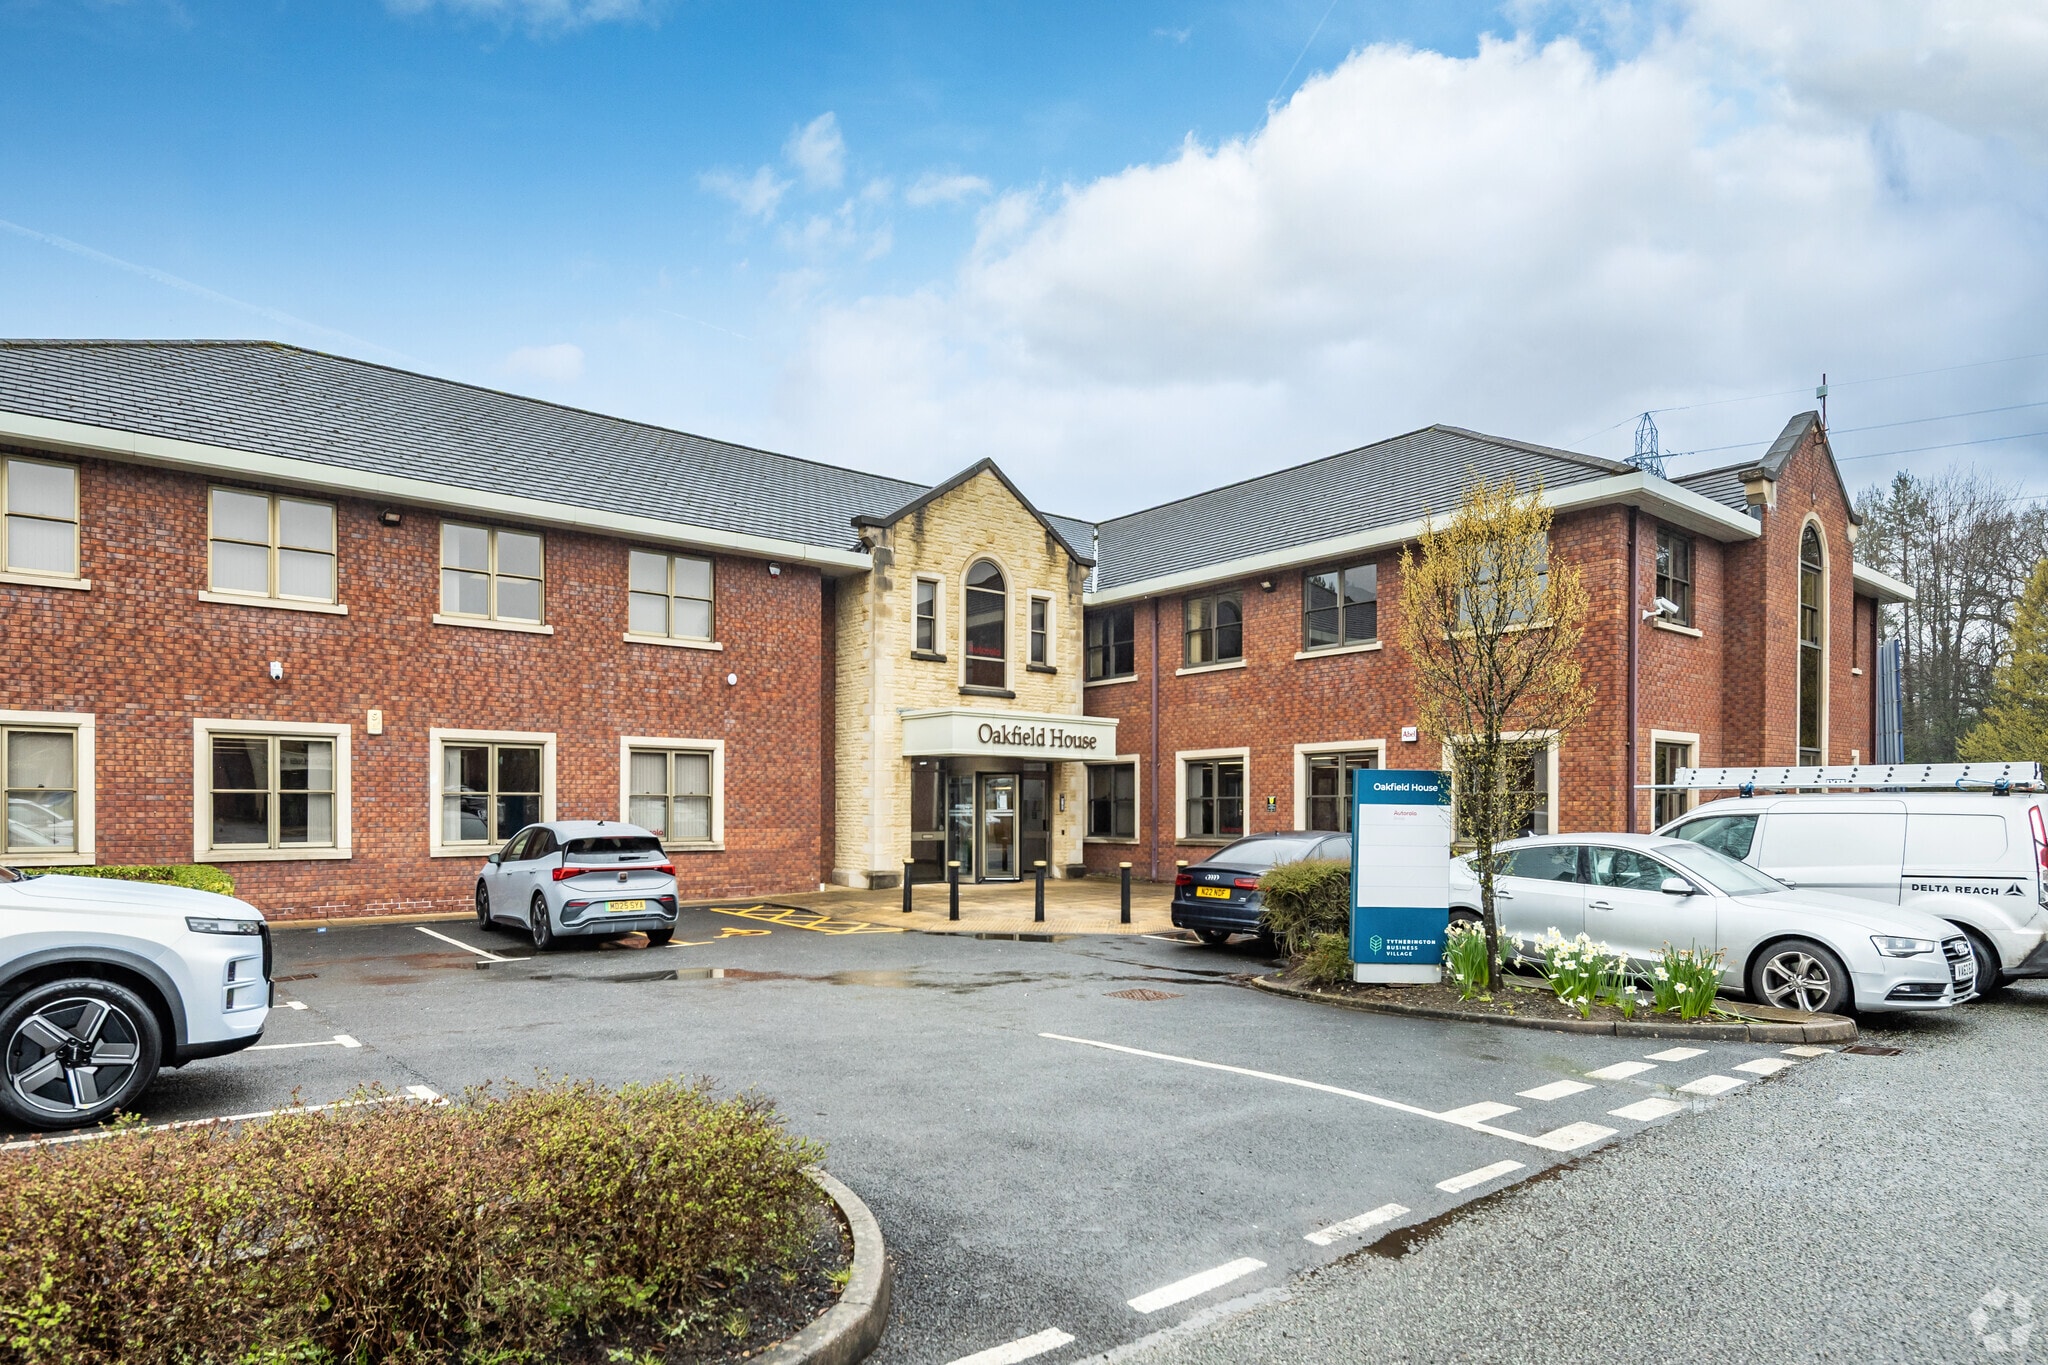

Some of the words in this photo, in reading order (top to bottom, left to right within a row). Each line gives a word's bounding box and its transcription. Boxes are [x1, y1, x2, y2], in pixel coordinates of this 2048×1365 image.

[978, 723, 1045, 747] Oakfield
[1049, 728, 1097, 750] House
[1373, 782, 1409, 791] Oakfield
[1411, 783, 1438, 792] House
[1911, 884, 1950, 893] DELTA
[1955, 886, 1999, 895] REACH
[630, 901, 644, 909] SYA
